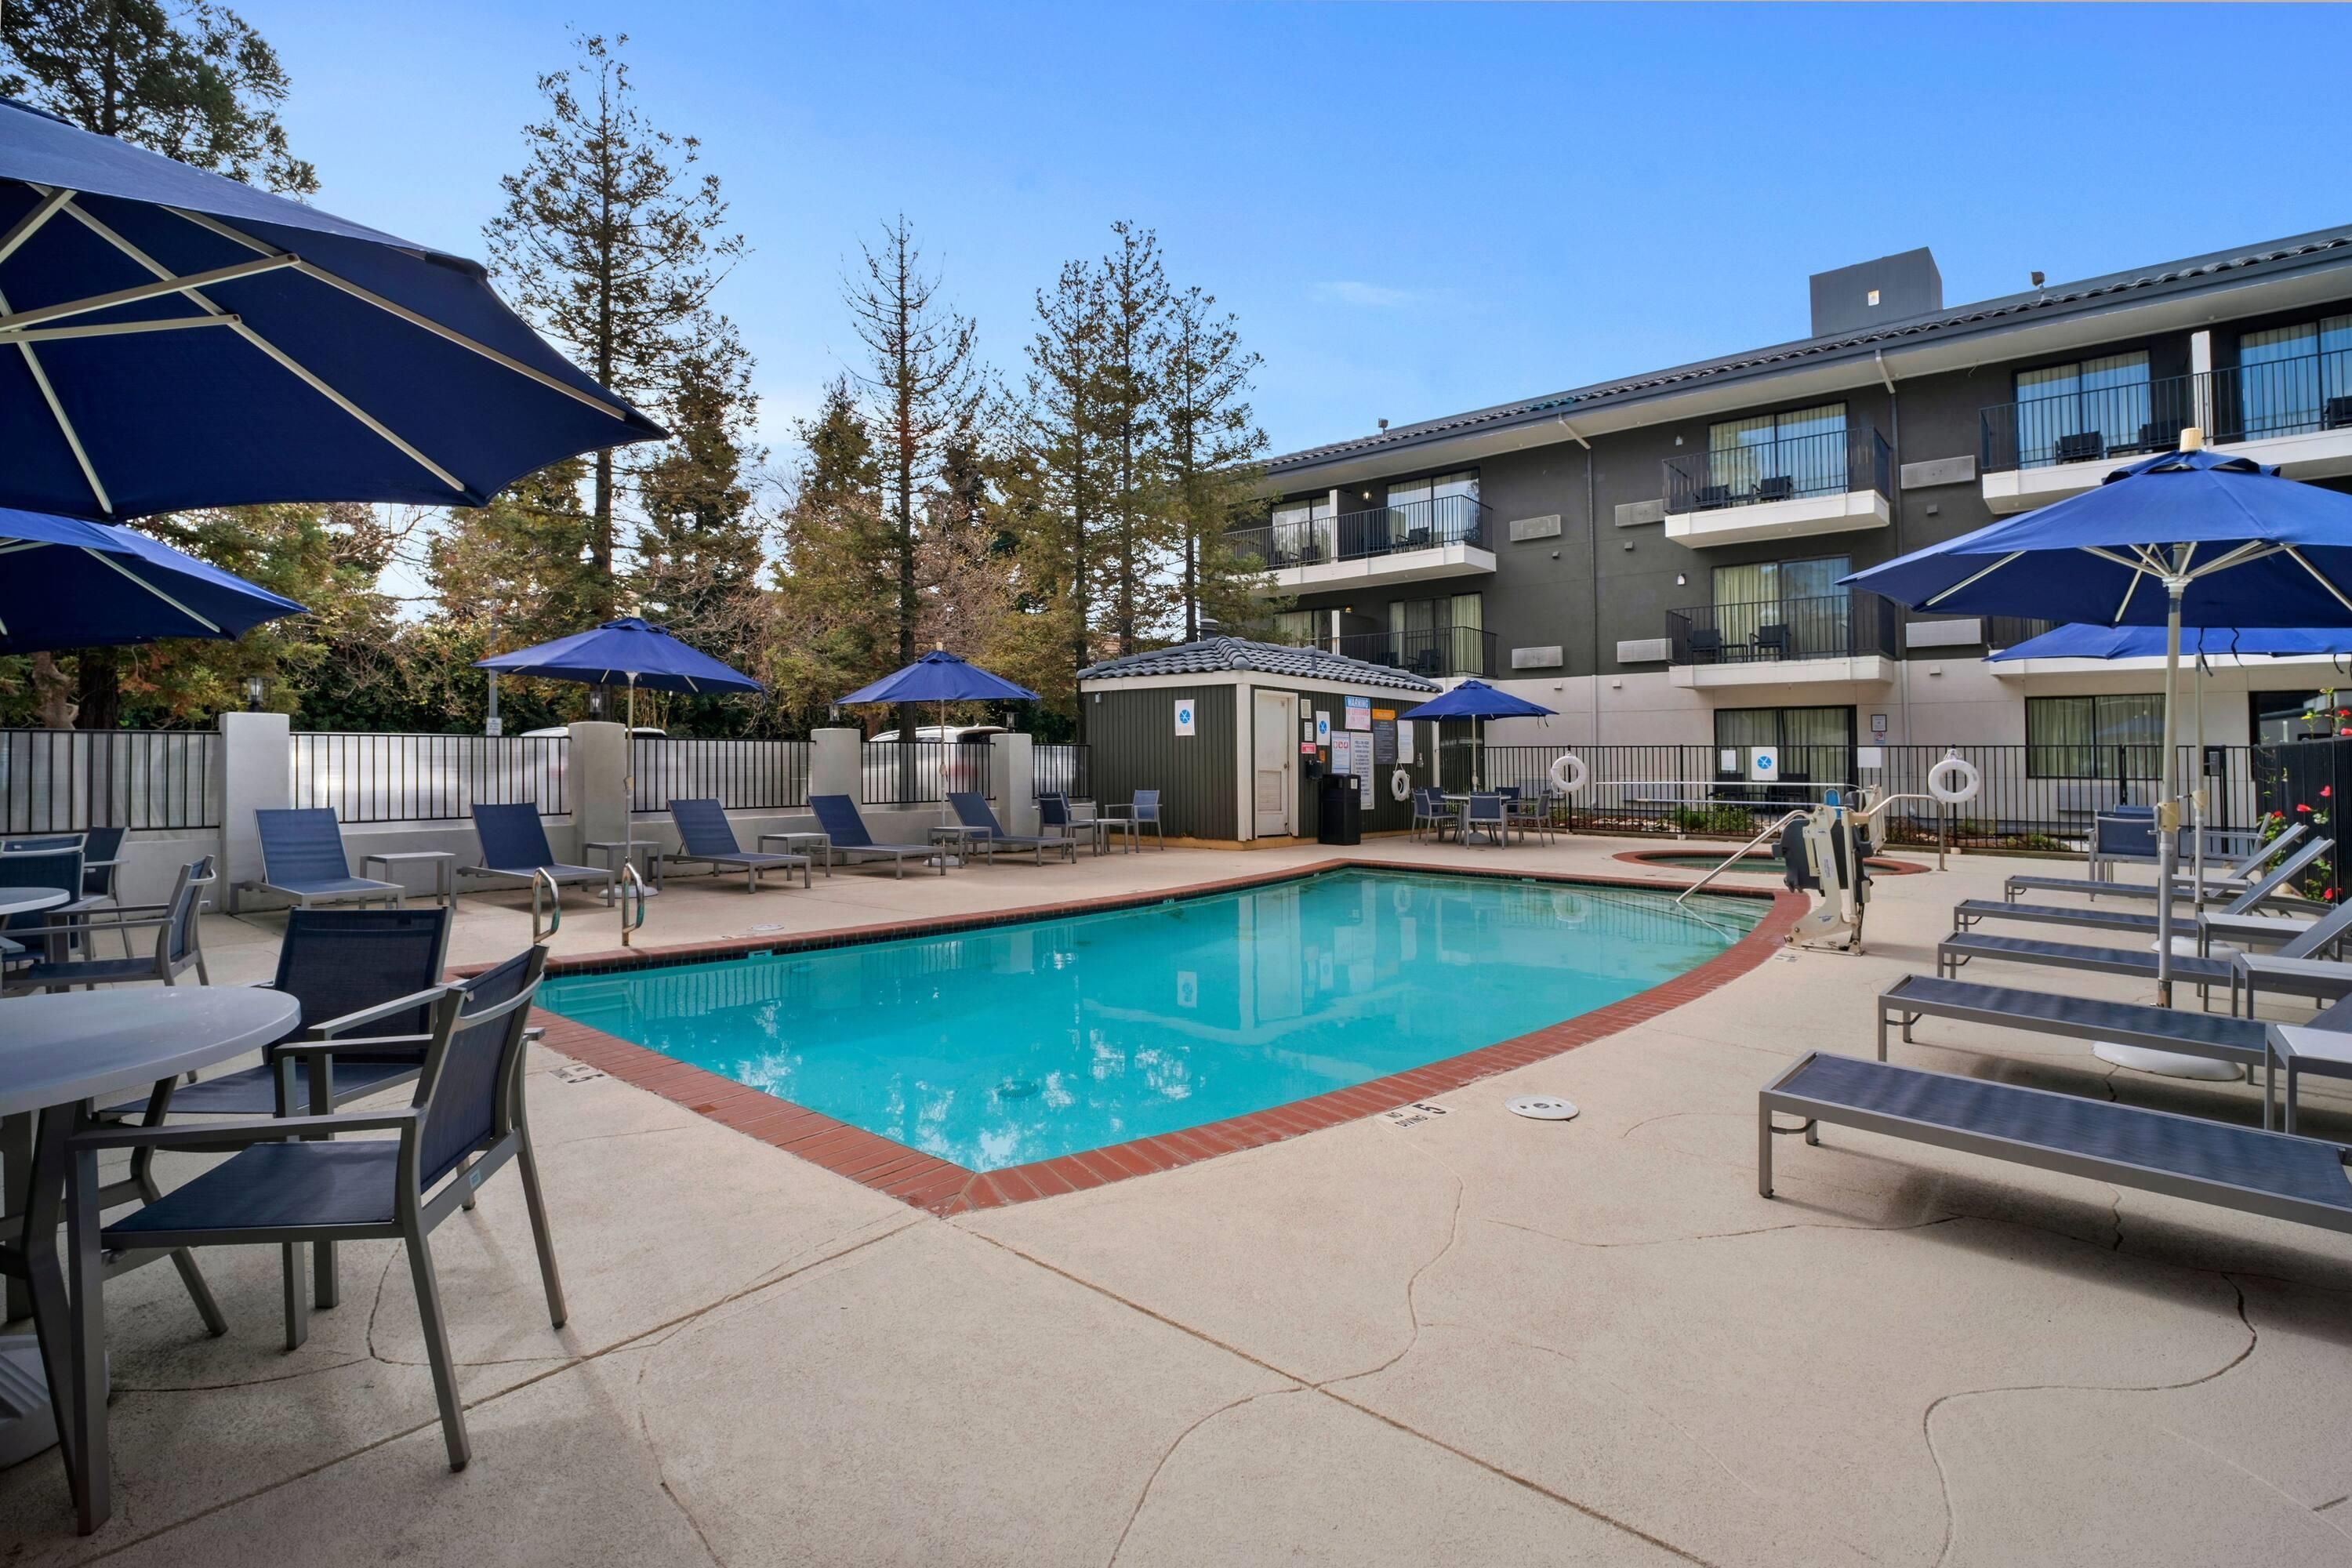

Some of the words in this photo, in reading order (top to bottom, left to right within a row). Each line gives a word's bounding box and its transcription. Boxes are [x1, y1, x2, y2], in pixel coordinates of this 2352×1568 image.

[1348, 697, 1368, 708] WARNING
[1413, 1103, 1447, 1115] 5
[1395, 1115, 1428, 1127] DIVING
